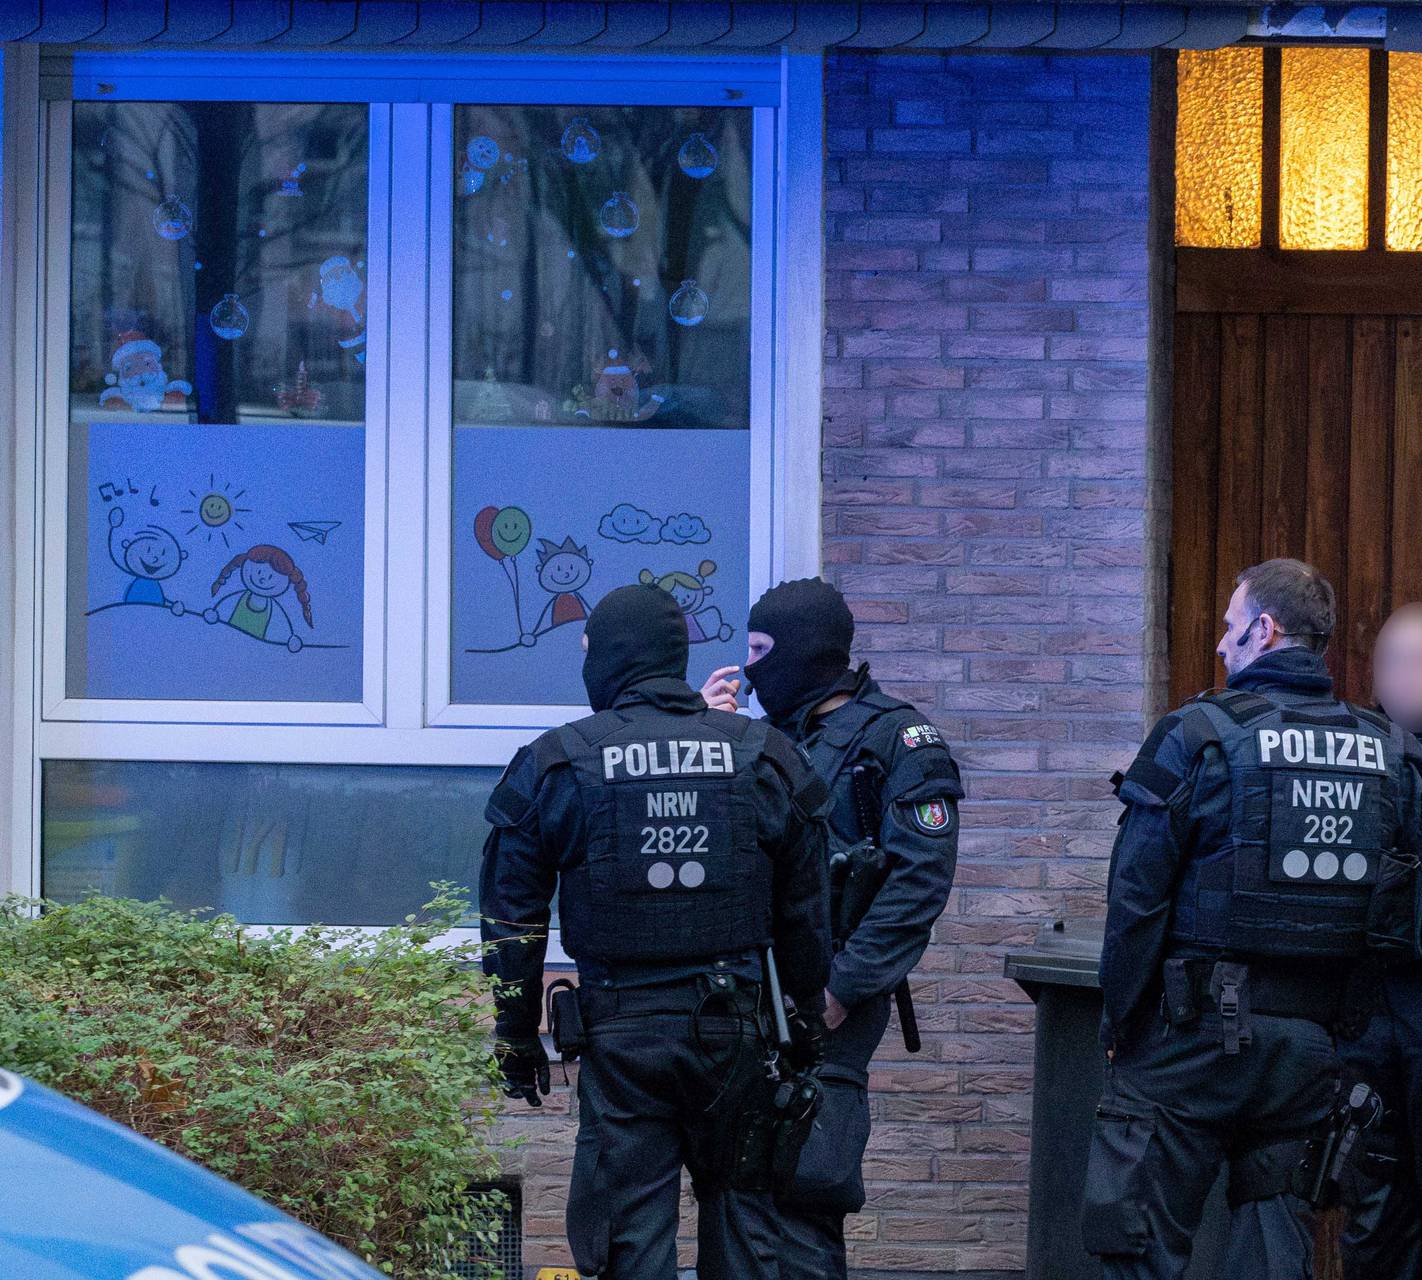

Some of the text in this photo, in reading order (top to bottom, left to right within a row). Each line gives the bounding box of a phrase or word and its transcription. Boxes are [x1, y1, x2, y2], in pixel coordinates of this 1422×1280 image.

[603, 740, 734, 779] POLIZEI
[1259, 728, 1386, 771] POLIZEI
[647, 792, 698, 817] NRW
[1292, 779, 1363, 811] NRW
[640, 825, 709, 854] 2822
[1303, 815, 1353, 844] 282
